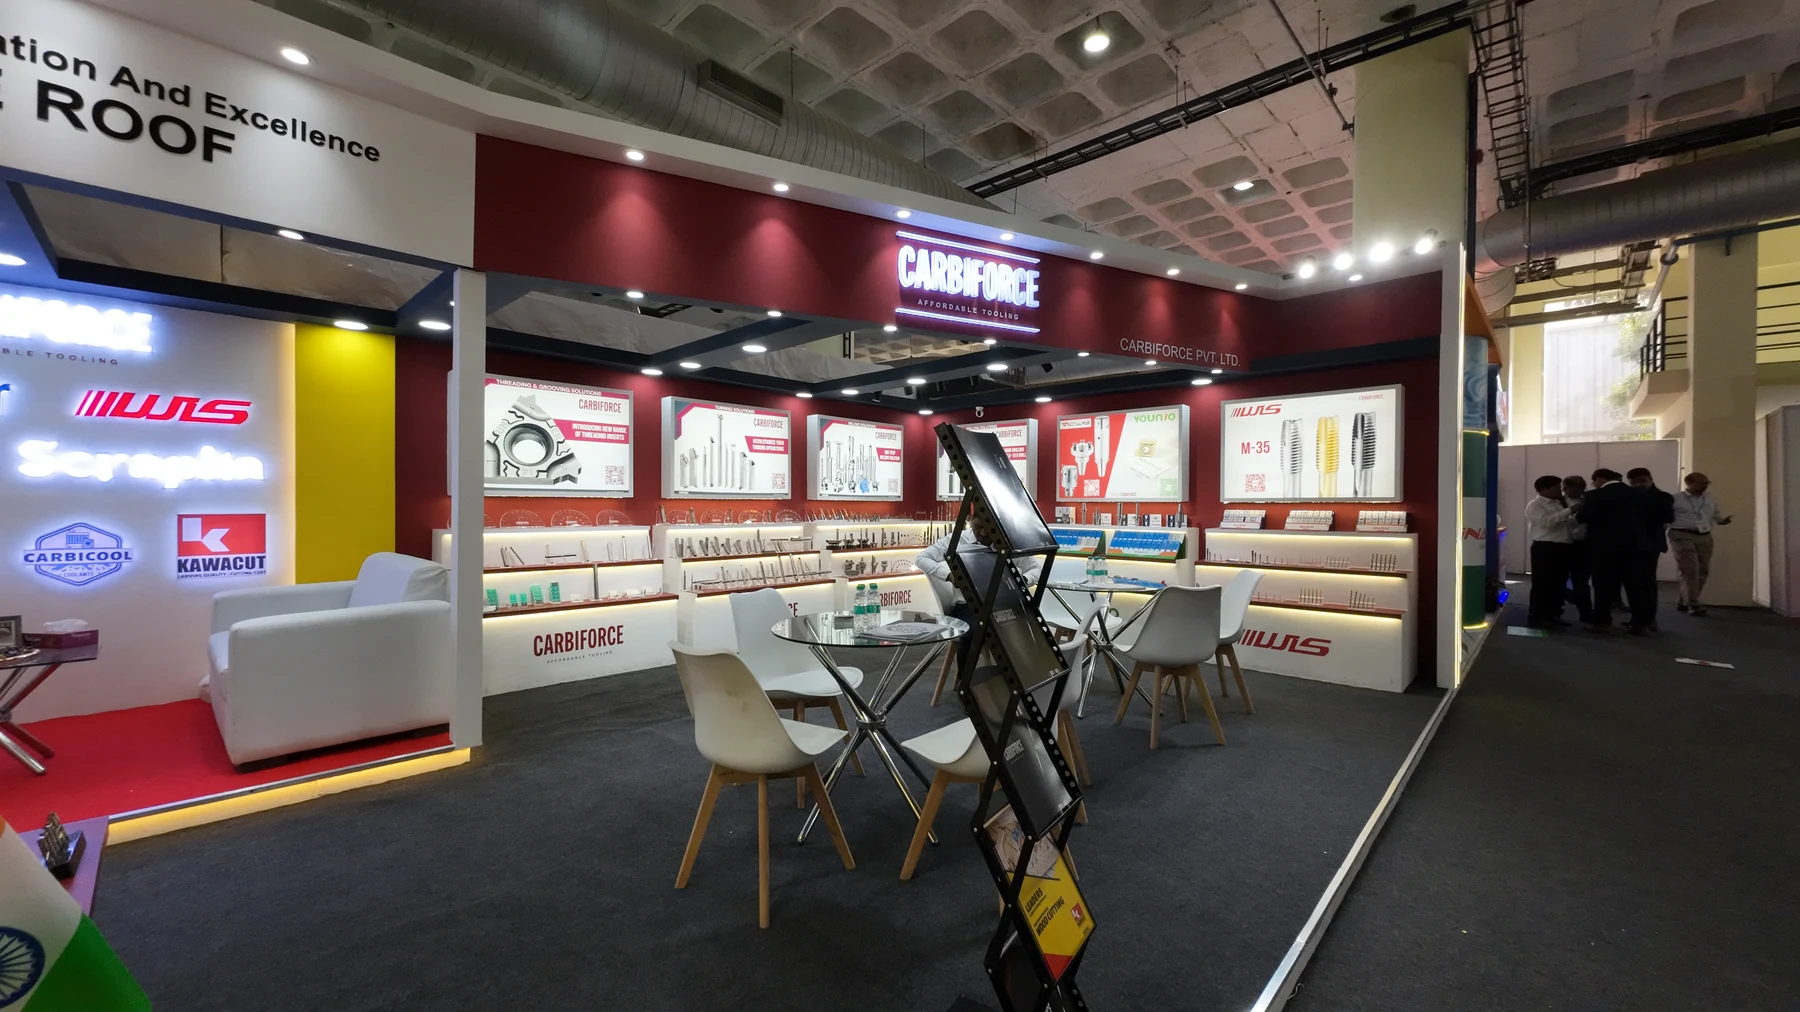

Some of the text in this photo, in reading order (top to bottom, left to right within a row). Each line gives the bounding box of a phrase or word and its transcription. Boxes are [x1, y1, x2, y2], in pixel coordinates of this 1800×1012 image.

[37, 79, 235, 163] ROOF
[110, 66, 190, 107] And
[206, 91, 380, 162] Excellence
[898, 245, 1040, 308] CARBIFORCE
[918, 299, 1019, 320] AFFORDABLE TOOLING
[45, 352, 118, 365] TOOLING
[1120, 338, 1241, 367] CARBIFORCE PVT. LTD.
[496, 379, 532, 388] THREADING
[539, 384, 570, 393] GROOVING
[571, 388, 602, 396] SOLUTIONS
[579, 399, 622, 413] CARBIFORCE
[754, 418, 783, 429] CARBIFORCE
[1241, 441, 1271, 454] M-35
[24, 551, 132, 563] CARBICOOL
[177, 555, 266, 573] KAWACUT
[533, 625, 624, 657] CARBIFORCE
[547, 655, 585, 664] AFFORDABLE
[1025, 887, 1043, 914] LEADERS
[1036, 916, 1050, 936] WOOD
[1047, 896, 1065, 921] CUTTING
